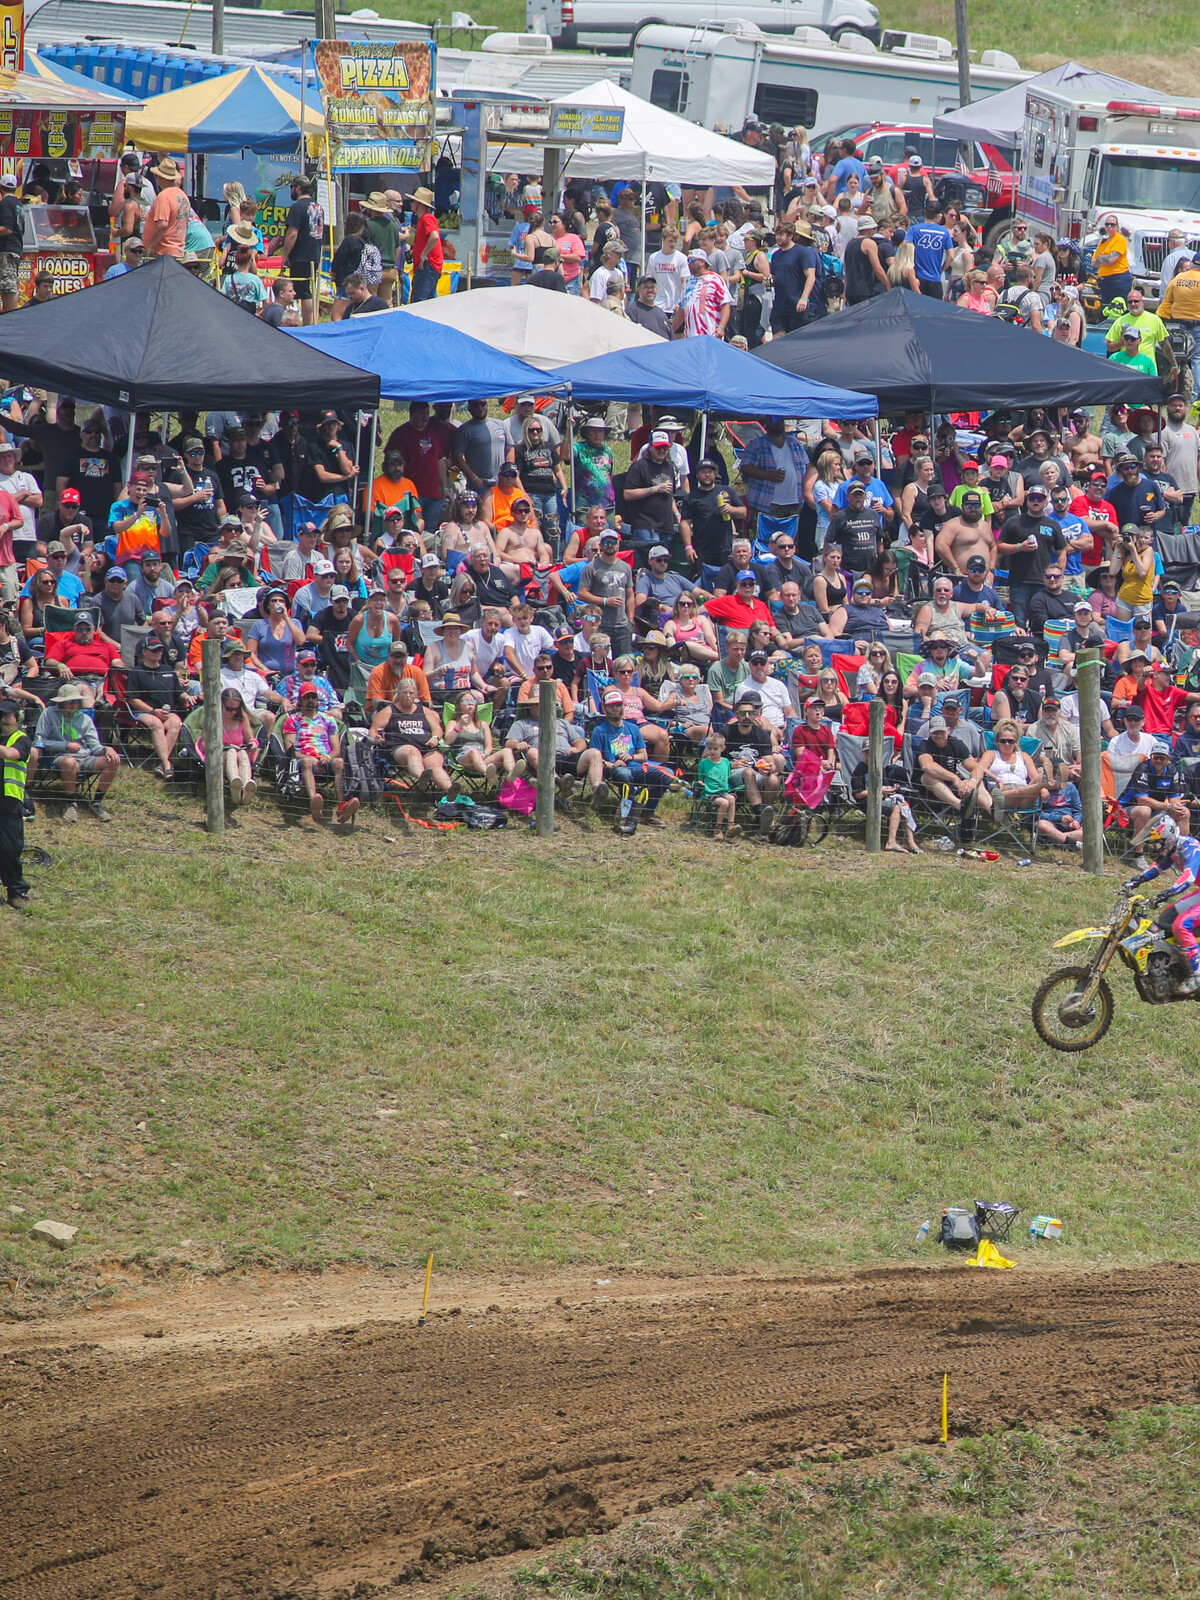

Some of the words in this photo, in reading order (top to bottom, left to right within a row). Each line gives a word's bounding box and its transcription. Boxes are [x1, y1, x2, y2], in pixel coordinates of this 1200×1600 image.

[663, 58, 687, 68] Coachmn
[340, 57, 409, 90] PIZZA
[279, 155, 292, 164] NOT
[919, 234, 943, 250] 46
[38, 258, 88, 276] LOADED
[52, 279, 82, 295] RIES
[1176, 278, 1200, 288] SECURITY
[847, 519, 862, 527] More
[857, 532, 870, 541] HD
